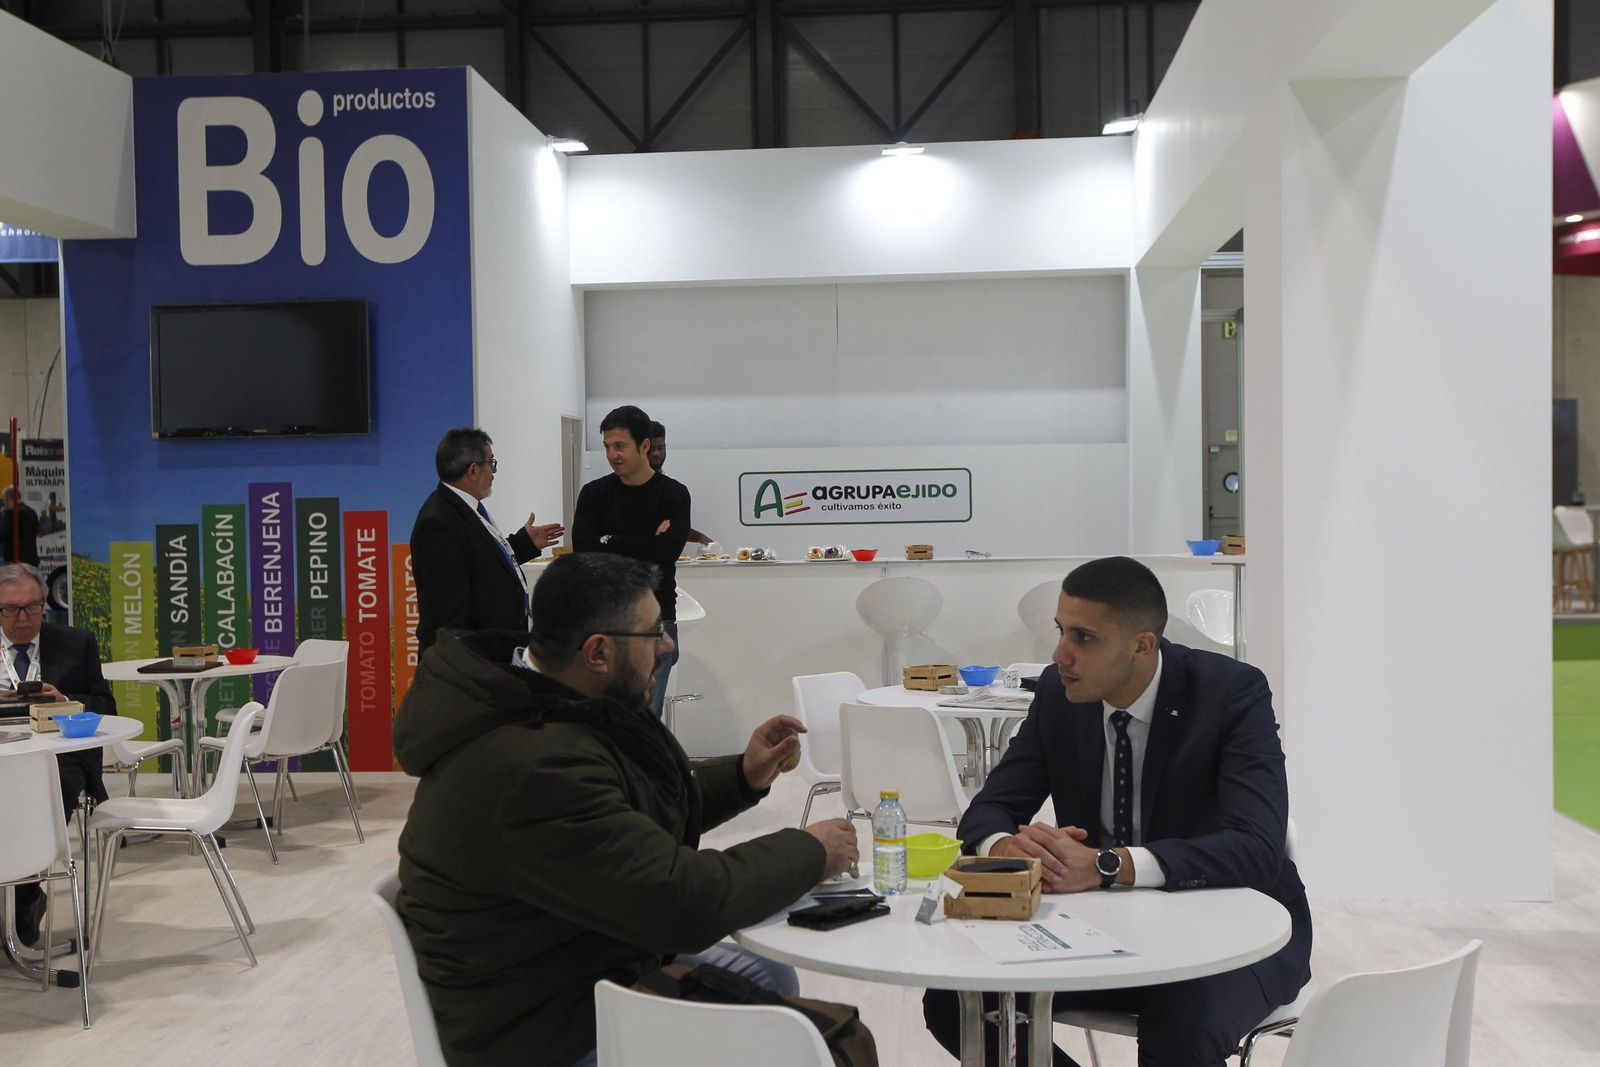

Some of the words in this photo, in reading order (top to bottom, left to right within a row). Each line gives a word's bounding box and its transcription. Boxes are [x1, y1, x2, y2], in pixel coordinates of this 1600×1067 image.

[333, 87, 436, 117] productos
[177, 90, 435, 266] Bio
[821, 502, 875, 512] cultivamos
[877, 501, 902, 511] éxito
[119, 553, 142, 634] MELÓN
[165, 534, 189, 624] SANDÍA
[211, 513, 236, 649] CALABACÍN
[261, 491, 283, 633] BERENJENA
[308, 511, 329, 600] PEPINO
[356, 527, 378, 624] TOMATE
[359, 631, 377, 713] TOMATO
